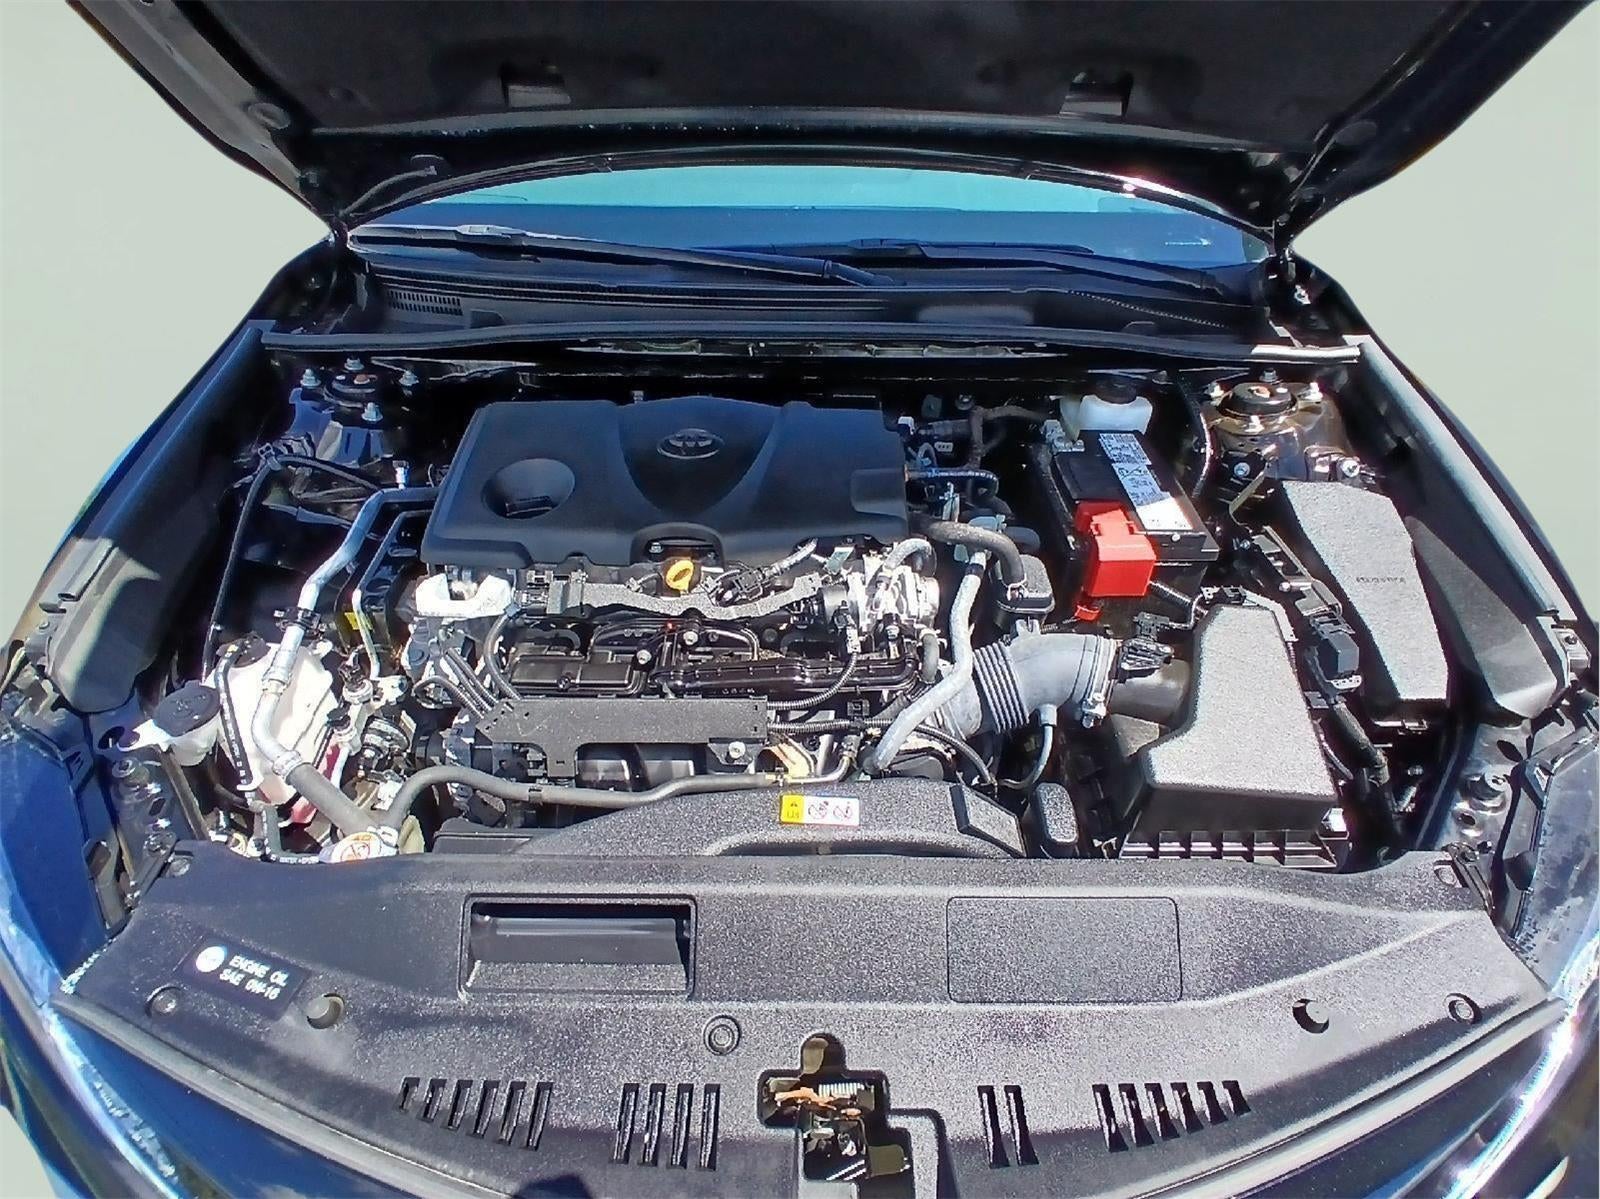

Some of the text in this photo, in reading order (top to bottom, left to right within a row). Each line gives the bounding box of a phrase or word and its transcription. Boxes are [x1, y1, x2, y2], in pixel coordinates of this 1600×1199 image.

[219, 968, 246, 986] SAE
[229, 955, 289, 988] ENGINE OIL
